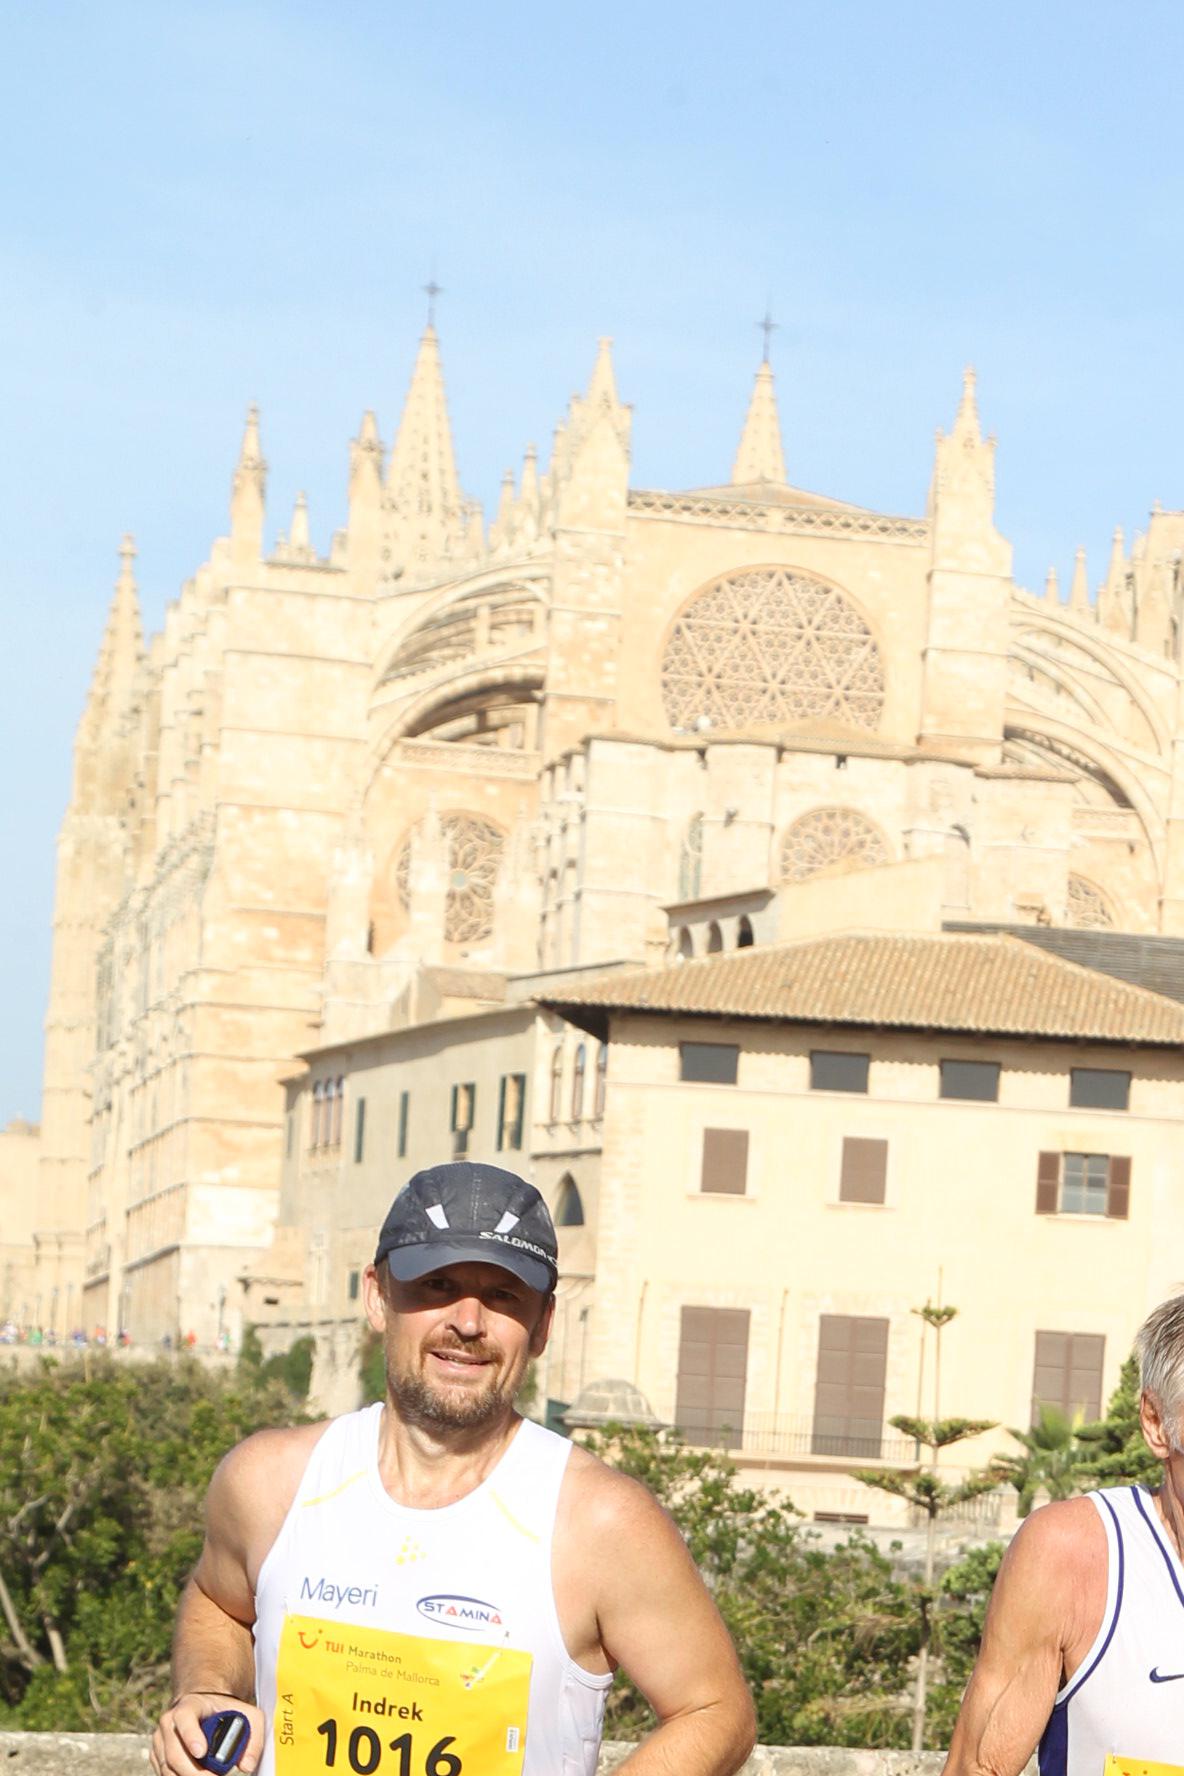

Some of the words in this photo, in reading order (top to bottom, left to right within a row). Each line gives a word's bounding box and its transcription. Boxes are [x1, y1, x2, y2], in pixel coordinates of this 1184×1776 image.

[479, 1231, 547, 1259] SALOMON
[300, 1577, 379, 1608] Mayeri
[424, 1602, 502, 1624] STAMINA
[325, 1641, 344, 1654] TUI
[348, 1646, 402, 1664] Marathon
[346, 1661, 377, 1676] Palma
[380, 1668, 393, 1678] de
[397, 1670, 440, 1686] Mallorca
[281, 1694, 294, 1705] A
[353, 1692, 424, 1722] Indrek
[280, 1710, 295, 1746] Start
